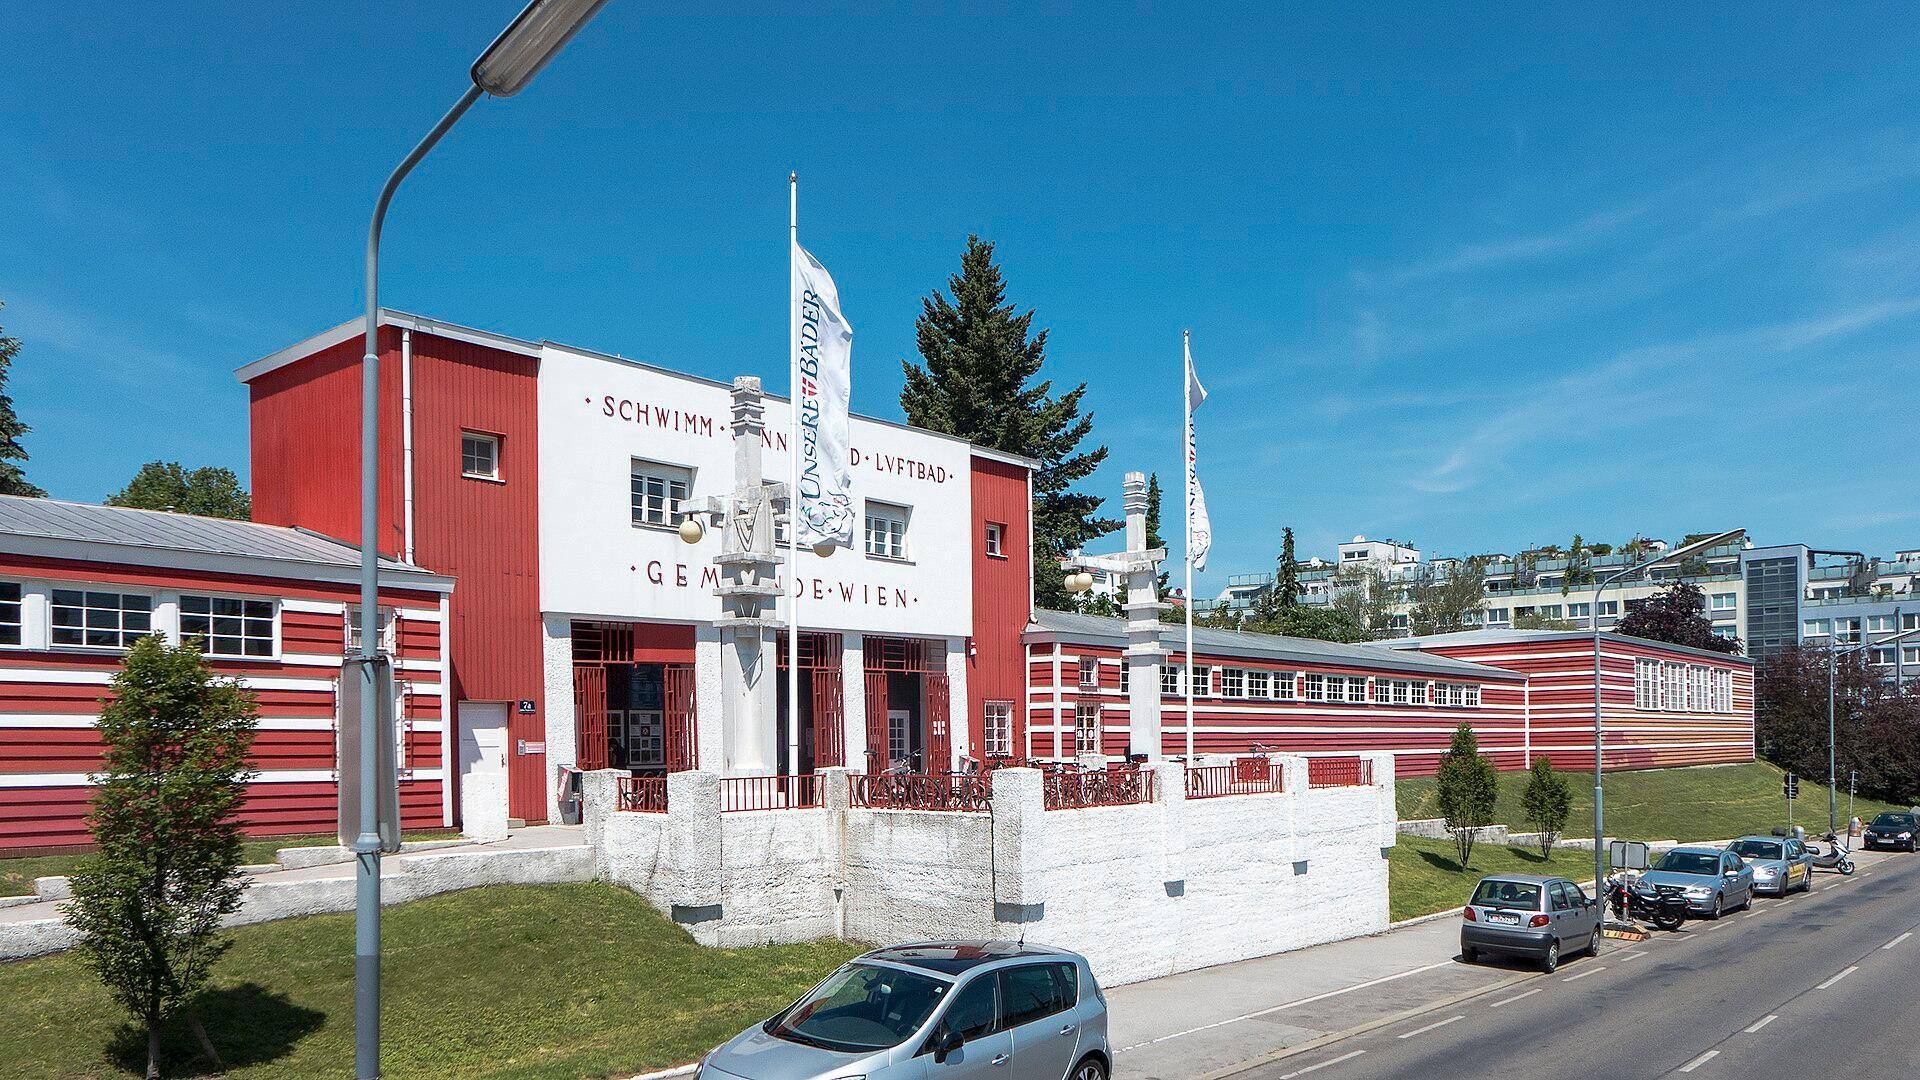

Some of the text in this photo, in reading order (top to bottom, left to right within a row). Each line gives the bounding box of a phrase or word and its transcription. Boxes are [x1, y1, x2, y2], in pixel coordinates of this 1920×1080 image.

[799, 289, 822, 382] BÄDER
[602, 395, 713, 438] SCHWIMM
[876, 453, 946, 484] LVFTBAD
[838, 581, 907, 608] WIEN
